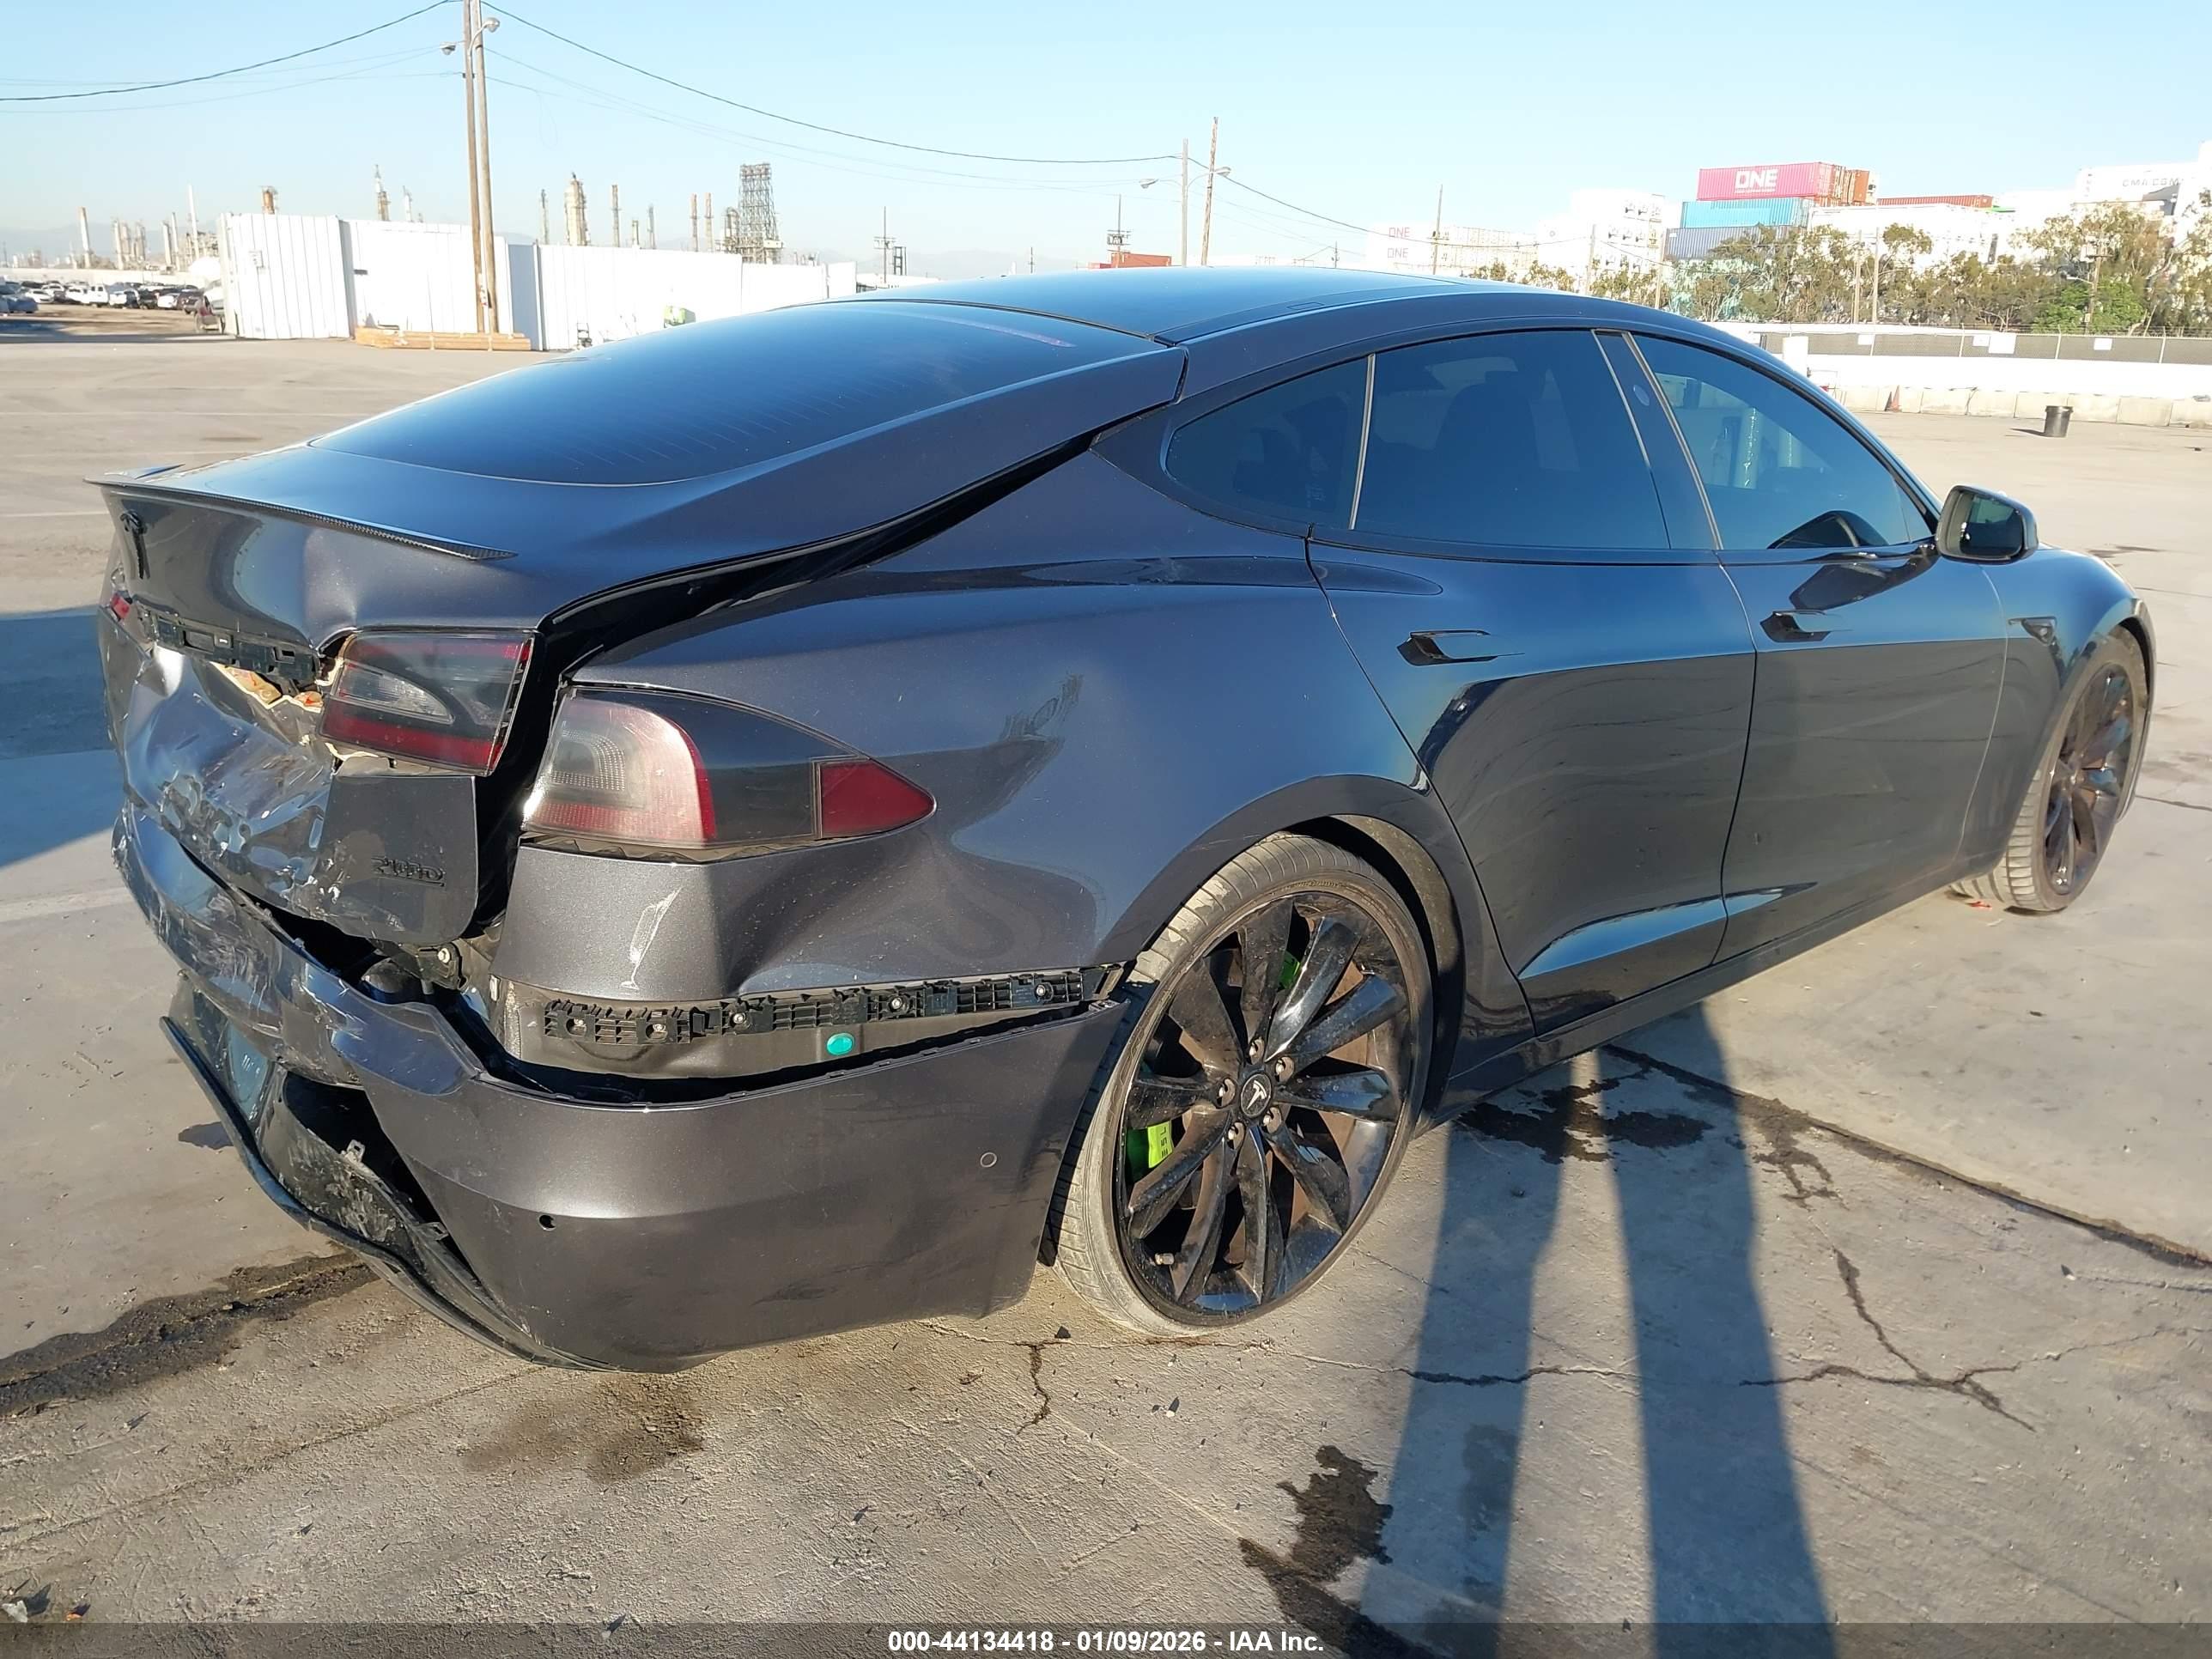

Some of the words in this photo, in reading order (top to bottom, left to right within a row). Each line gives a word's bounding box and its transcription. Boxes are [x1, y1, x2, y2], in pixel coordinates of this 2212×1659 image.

[1735, 168, 1778, 188] ONE
[2122, 179, 2148, 187] CMA
[1389, 226, 1410, 238] ONE
[1387, 247, 1408, 258] ONE
